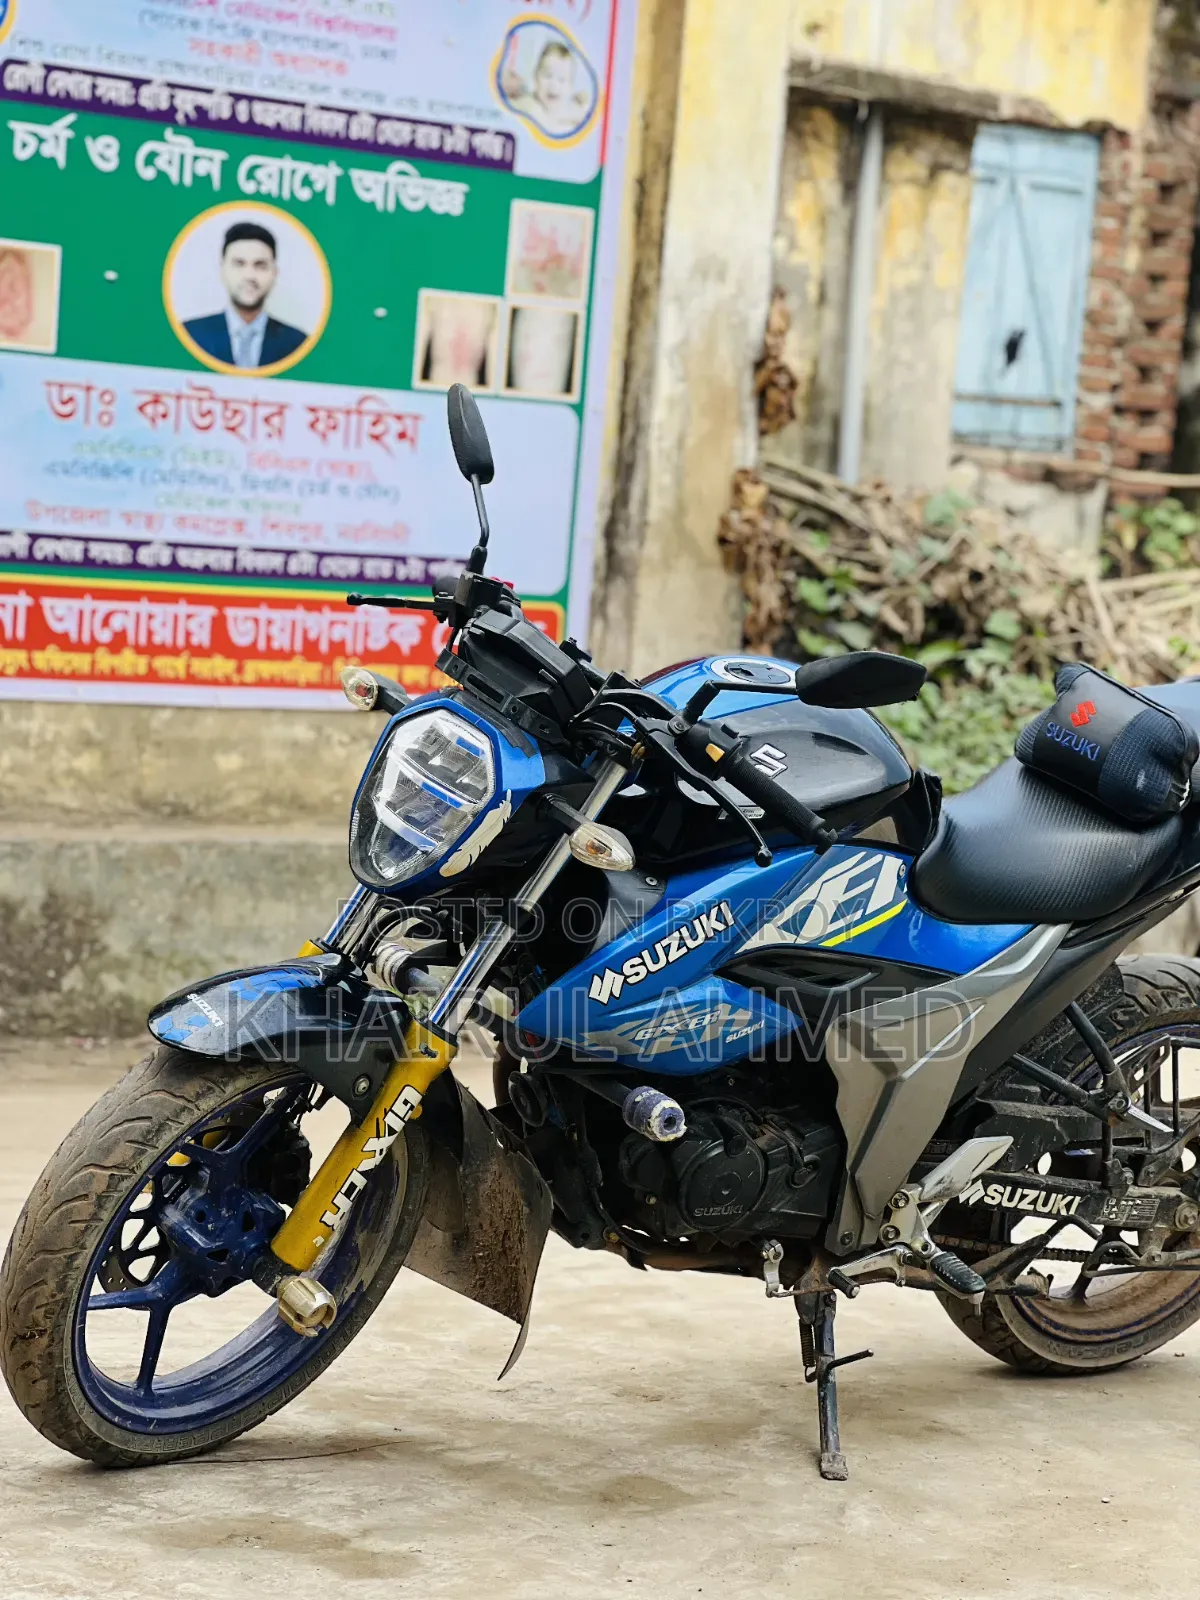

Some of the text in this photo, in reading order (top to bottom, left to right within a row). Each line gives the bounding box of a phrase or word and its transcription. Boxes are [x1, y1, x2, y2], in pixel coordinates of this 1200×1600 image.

[8, 113, 470, 217] চর্ম ও যৌন রোগে অভিজ্ঞ
[44, 379, 424, 457] ডাঃ কাউছার ফাহিম
[38, 592, 220, 650] আনোয়ার
[1045, 721, 1100, 761] SUZUKI
[621, 900, 735, 986] SUZUKI
[186, 992, 225, 1028] SUZUKI
[725, 1019, 765, 1044] SUZUKI
[693, 1204, 744, 1218] SUZUKI
[983, 1183, 1082, 1216] SUZUKI
